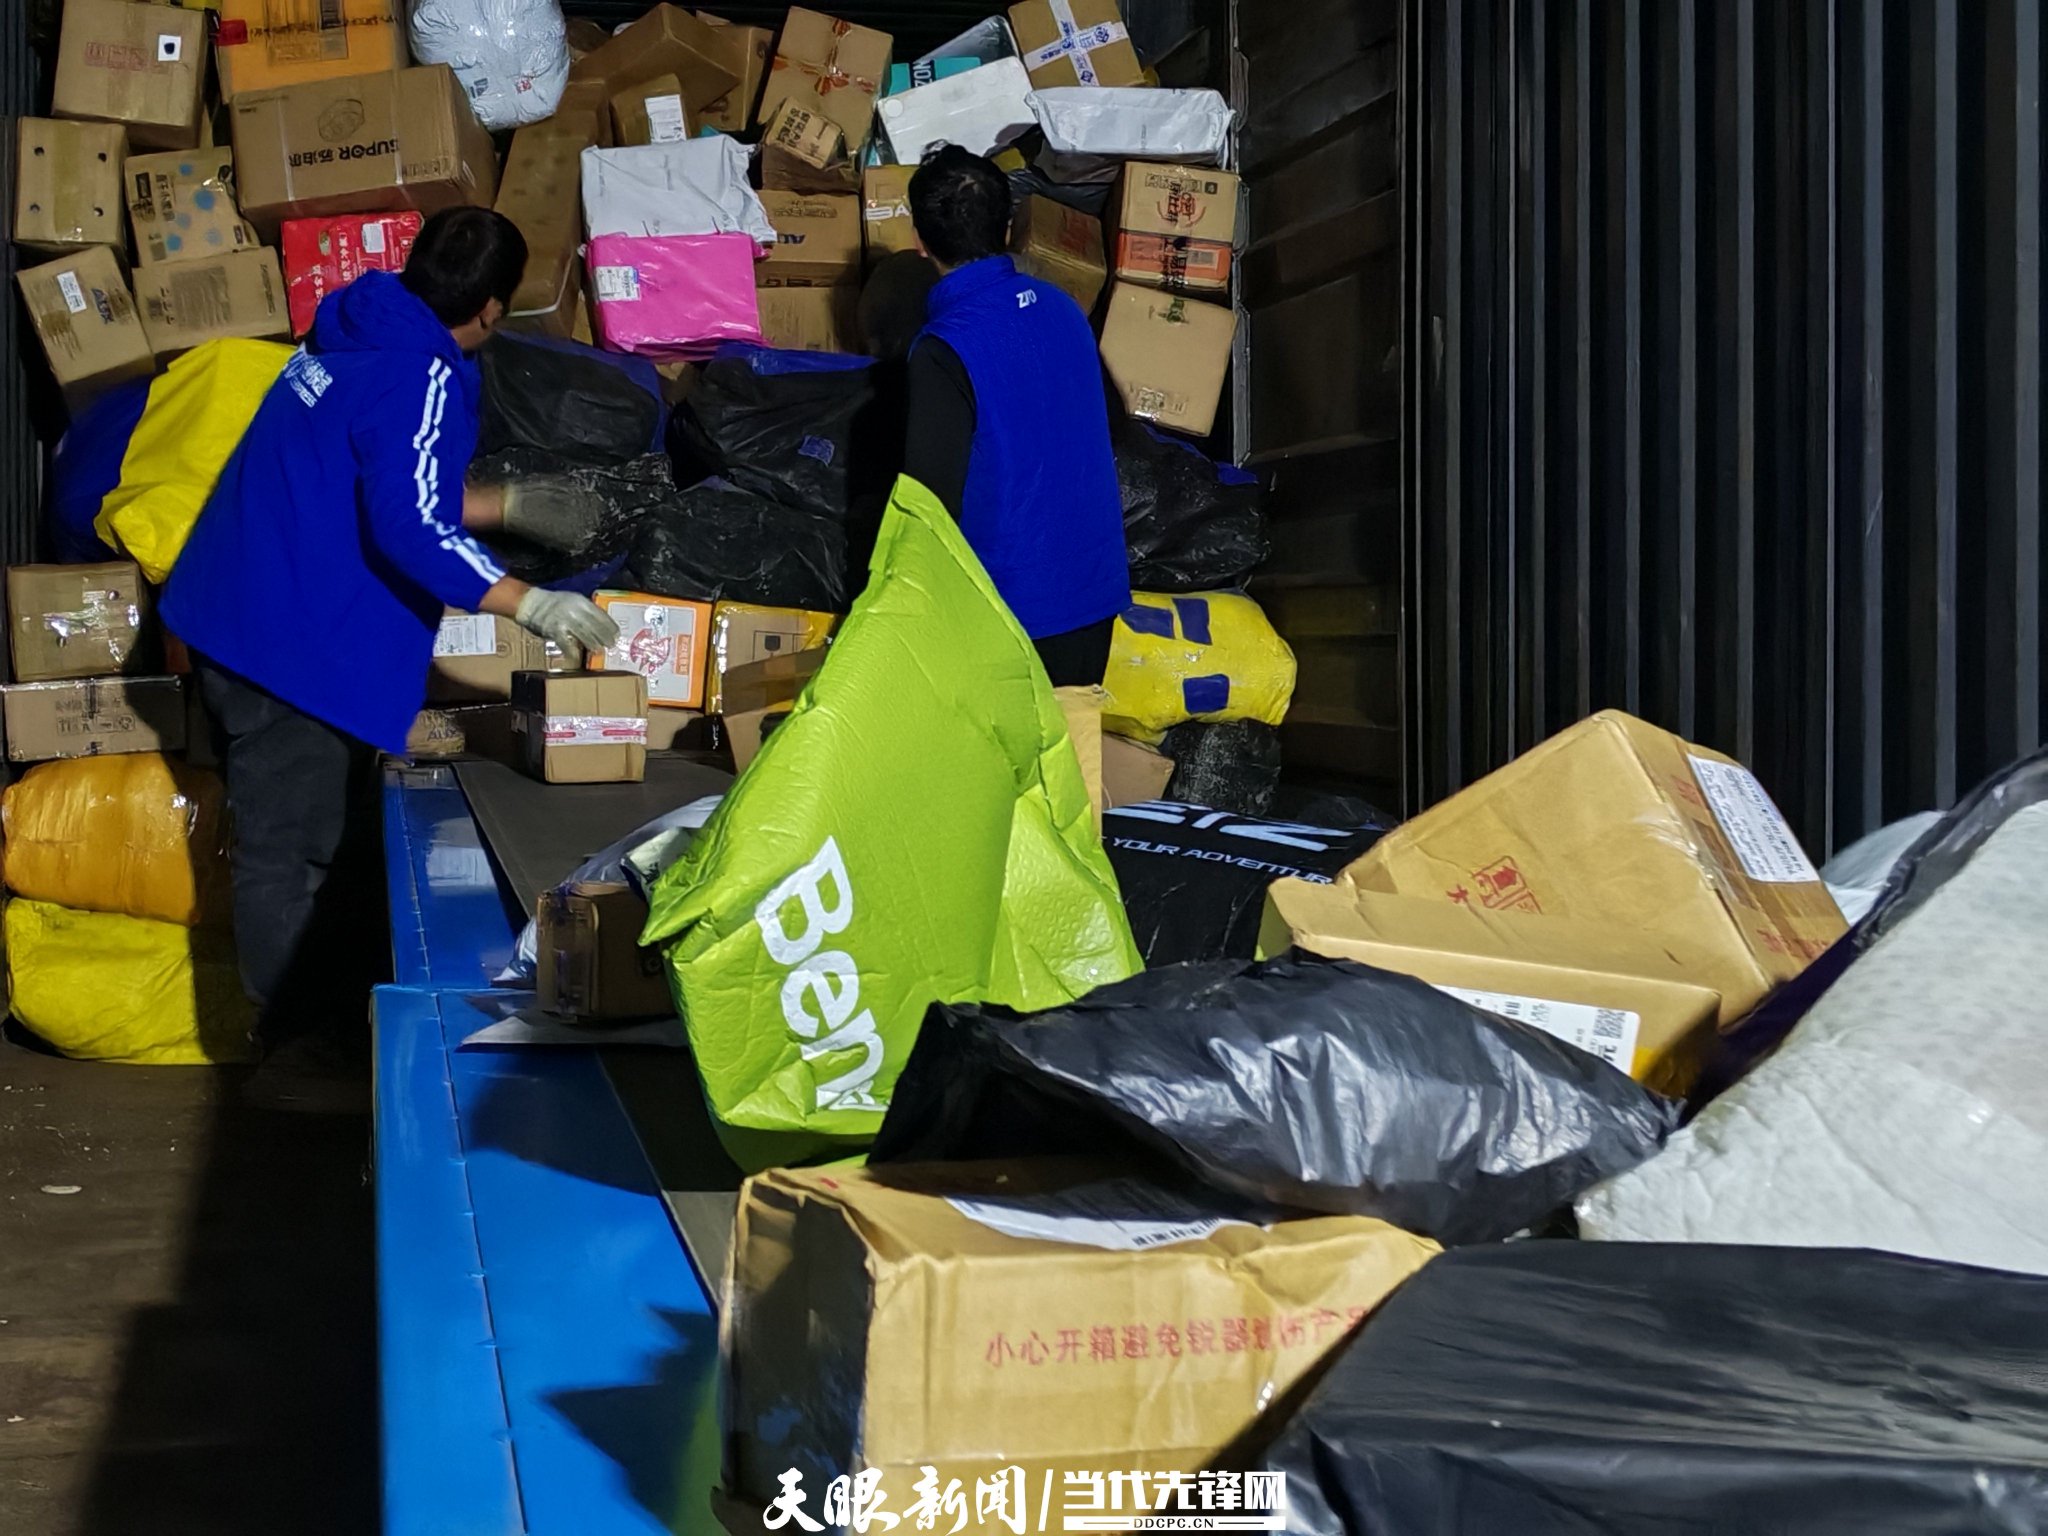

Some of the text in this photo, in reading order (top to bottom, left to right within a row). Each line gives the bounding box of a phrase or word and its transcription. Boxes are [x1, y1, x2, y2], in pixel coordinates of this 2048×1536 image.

[288, 137, 401, 169] SUPOR 苏泊尔
[1112, 837, 1181, 855] YOUR
